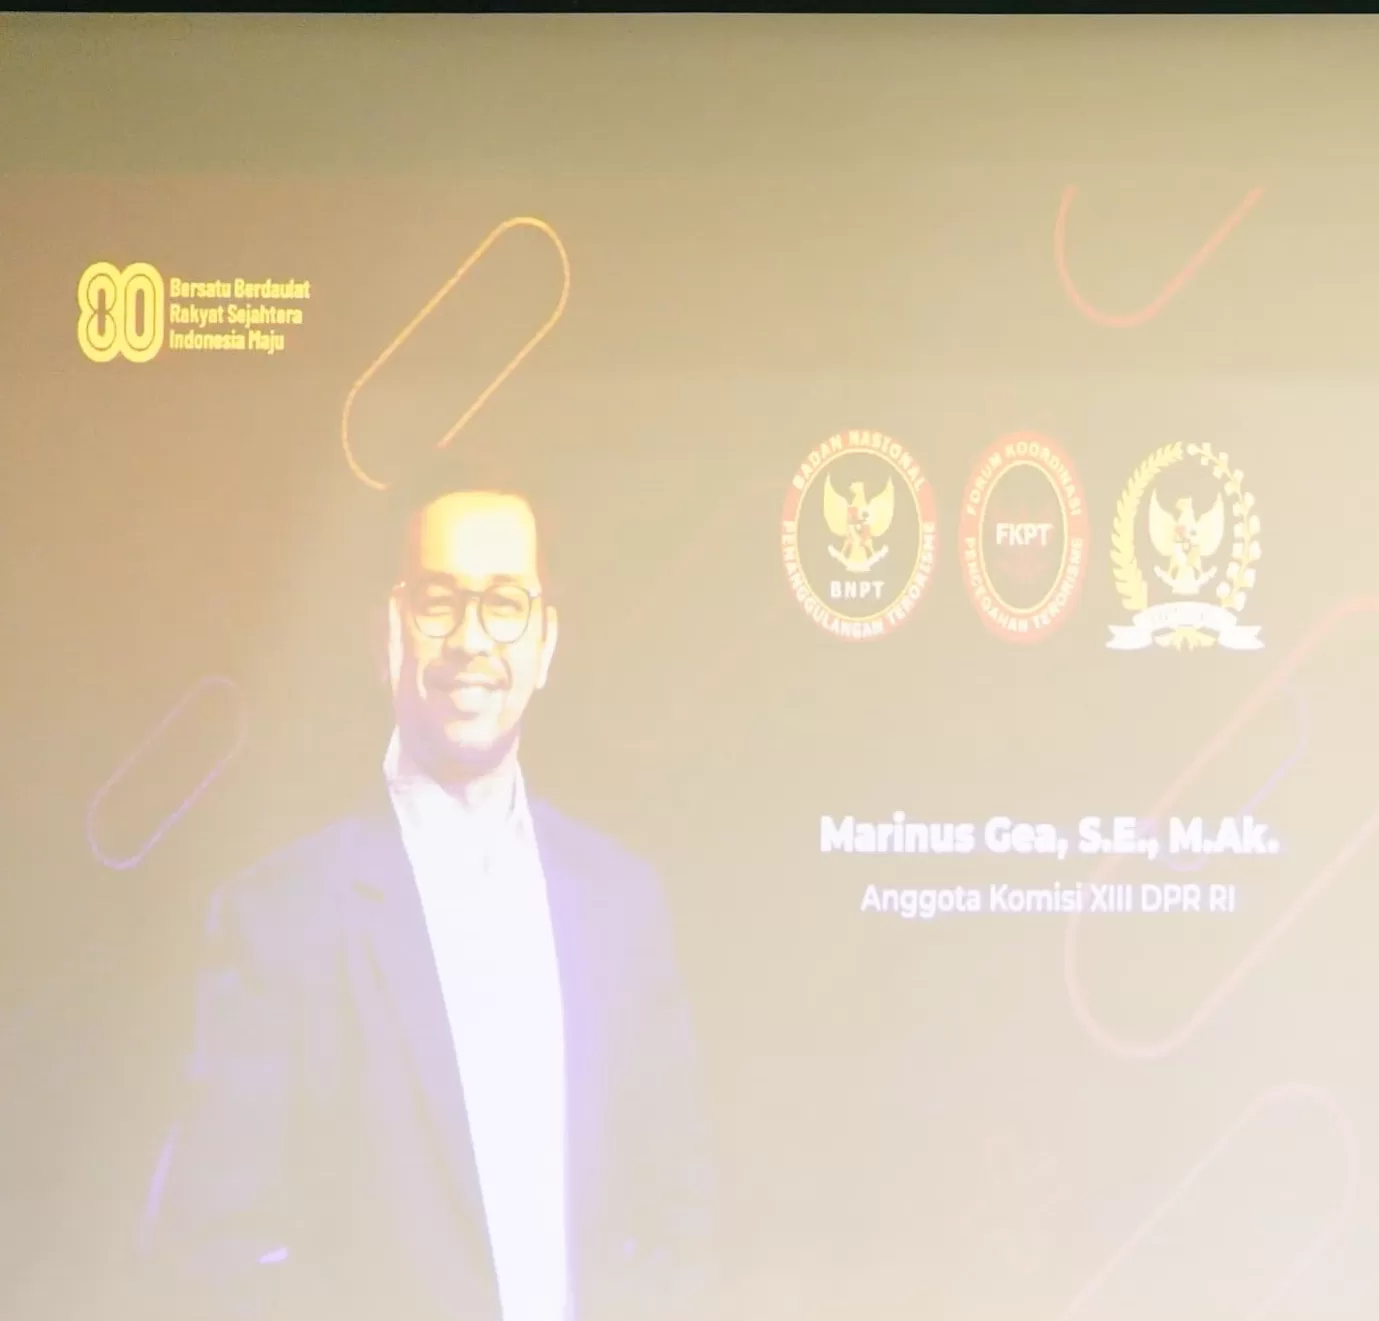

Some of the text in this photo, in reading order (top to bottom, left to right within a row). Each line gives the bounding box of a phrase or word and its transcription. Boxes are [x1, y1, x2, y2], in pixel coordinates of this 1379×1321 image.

[169, 278, 310, 299] Bersatu Berdaulat
[78, 262, 164, 362] 80
[170, 304, 302, 328] Rakyat Sejahtera
[169, 330, 284, 354] Indonesia Maju
[848, 429, 925, 491] NASIONAL
[996, 522, 1054, 546] FKPT
[830, 580, 885, 600] BNPT
[820, 810, 1280, 860] Marinus Gea, S.E., M.Ak.
[860, 881, 1236, 918] Anggota Komisi XIII DPR RI
